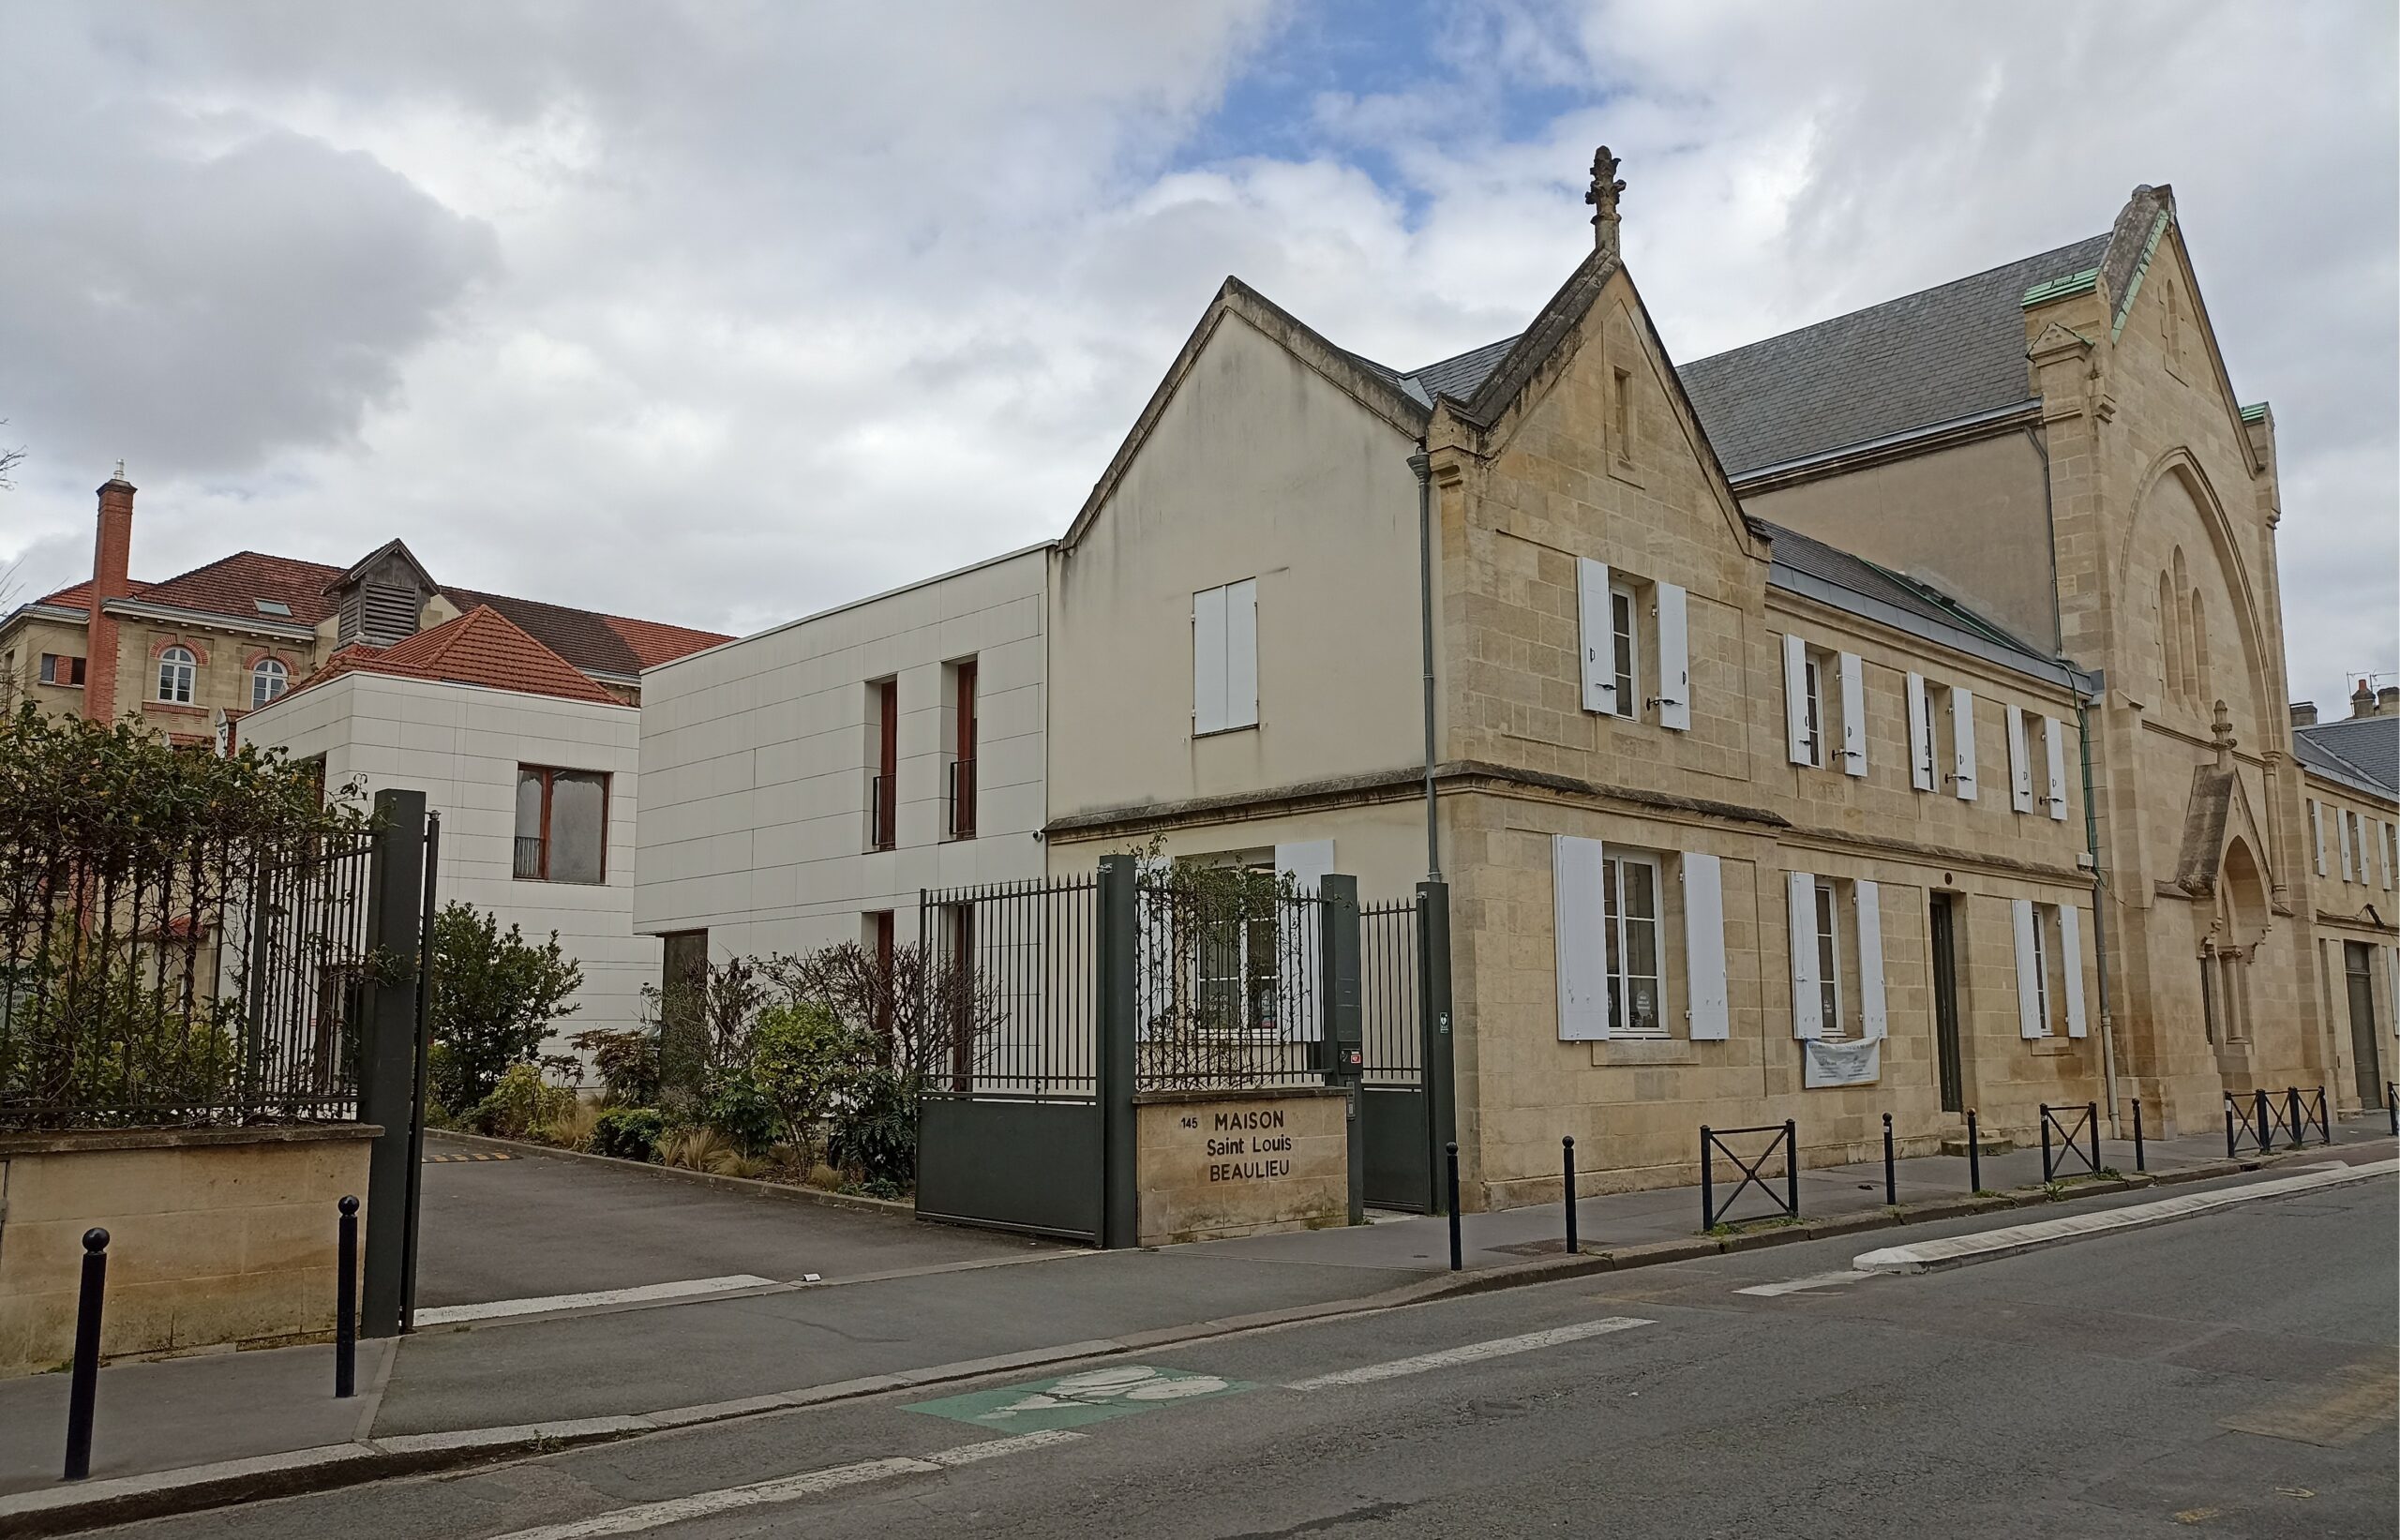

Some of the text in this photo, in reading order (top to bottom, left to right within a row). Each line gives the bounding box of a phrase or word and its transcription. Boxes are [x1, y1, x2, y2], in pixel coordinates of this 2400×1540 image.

[1181, 1116, 1198, 1129] 145
[1214, 1110, 1284, 1131] MAISON
[1207, 1133, 1292, 1157] Saint Louis
[1209, 1159, 1290, 1182] BEAULIEU
